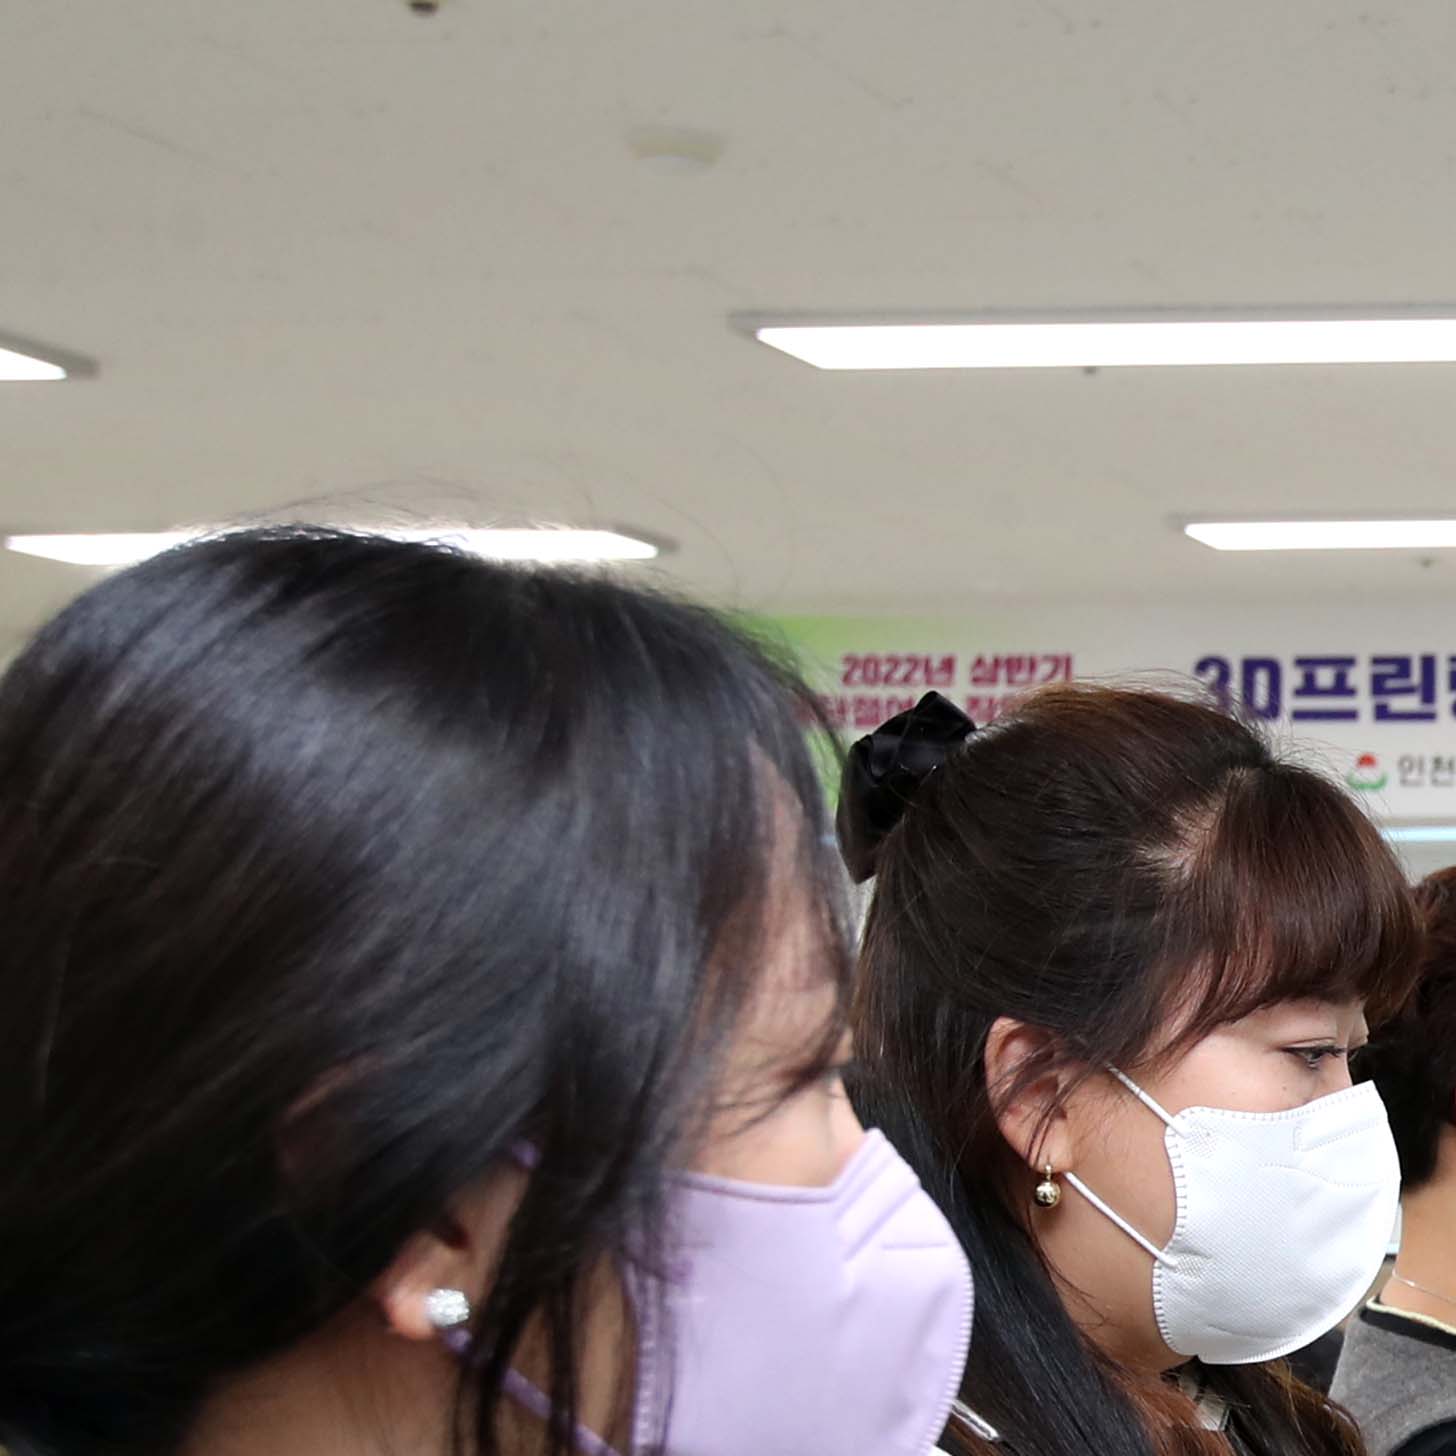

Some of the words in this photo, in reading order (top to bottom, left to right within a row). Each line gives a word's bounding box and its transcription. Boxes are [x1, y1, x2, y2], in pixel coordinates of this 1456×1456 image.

[842, 654, 957, 687] 2022년
[969, 652, 1074, 686] 상반기
[1399, 754, 1455, 785] 인천
